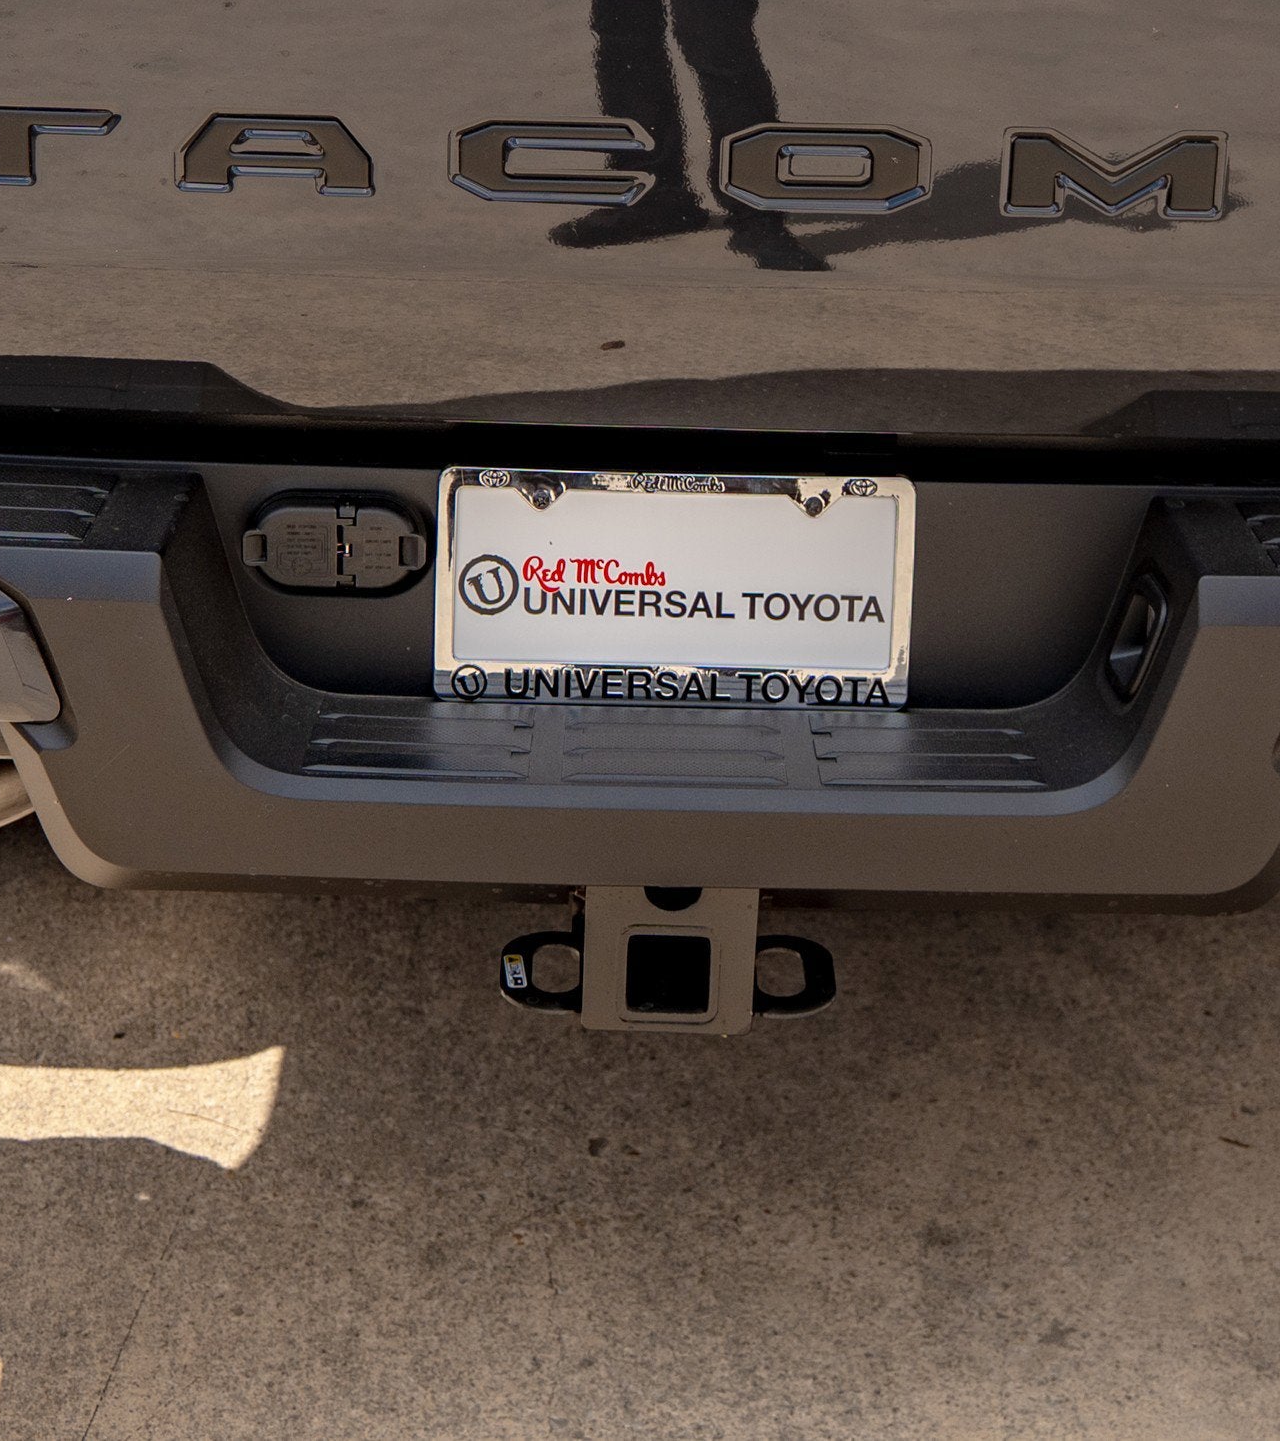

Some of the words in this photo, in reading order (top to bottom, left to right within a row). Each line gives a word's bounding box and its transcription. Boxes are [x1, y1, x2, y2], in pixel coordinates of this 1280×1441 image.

[522, 555, 566, 593] Red
[569, 557, 666, 587] McCombs
[523, 587, 735, 619] UNIVERSAL
[742, 592, 885, 623] TOYOTA
[503, 667, 731, 702] UNIVERSAL
[737, 672, 892, 707] TOYOTA
